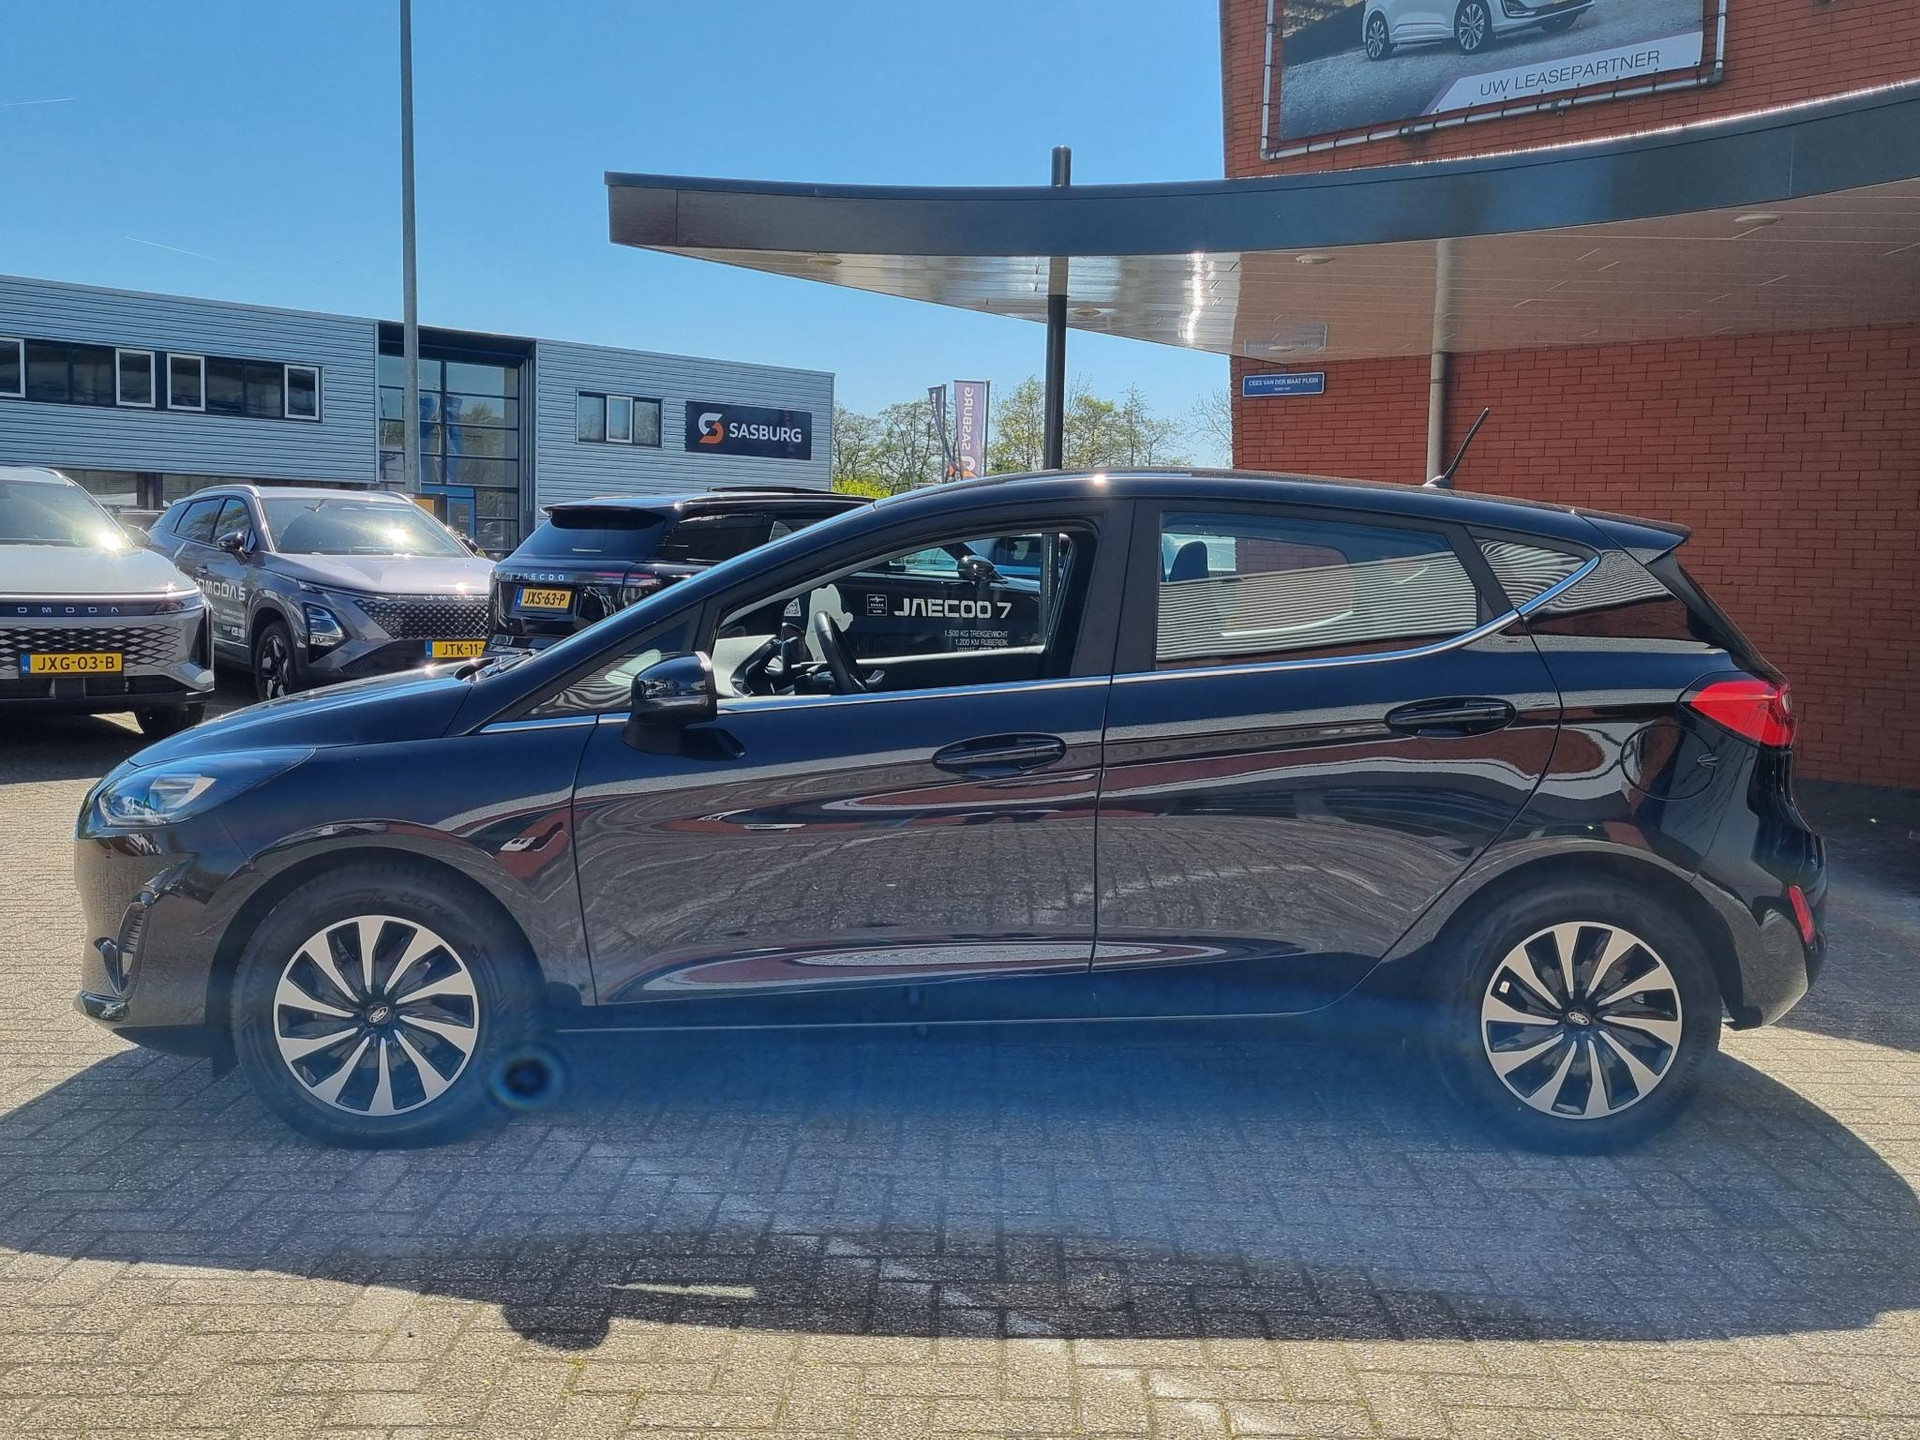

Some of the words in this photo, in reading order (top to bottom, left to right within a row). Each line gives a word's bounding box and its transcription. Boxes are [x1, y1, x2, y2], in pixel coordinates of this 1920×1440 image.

[1480, 79, 1510, 96] UW
[1514, 50, 1660, 90] LEASEPARTNER
[729, 422, 802, 443] SASBURG
[524, 591, 566, 606] JXS-63-P
[17, 606, 119, 614] OMODA
[894, 598, 992, 619] JAECOO
[996, 602, 1013, 619] 7
[442, 643, 483, 655] JTK-11-
[38, 656, 115, 671] JXG-03-B
